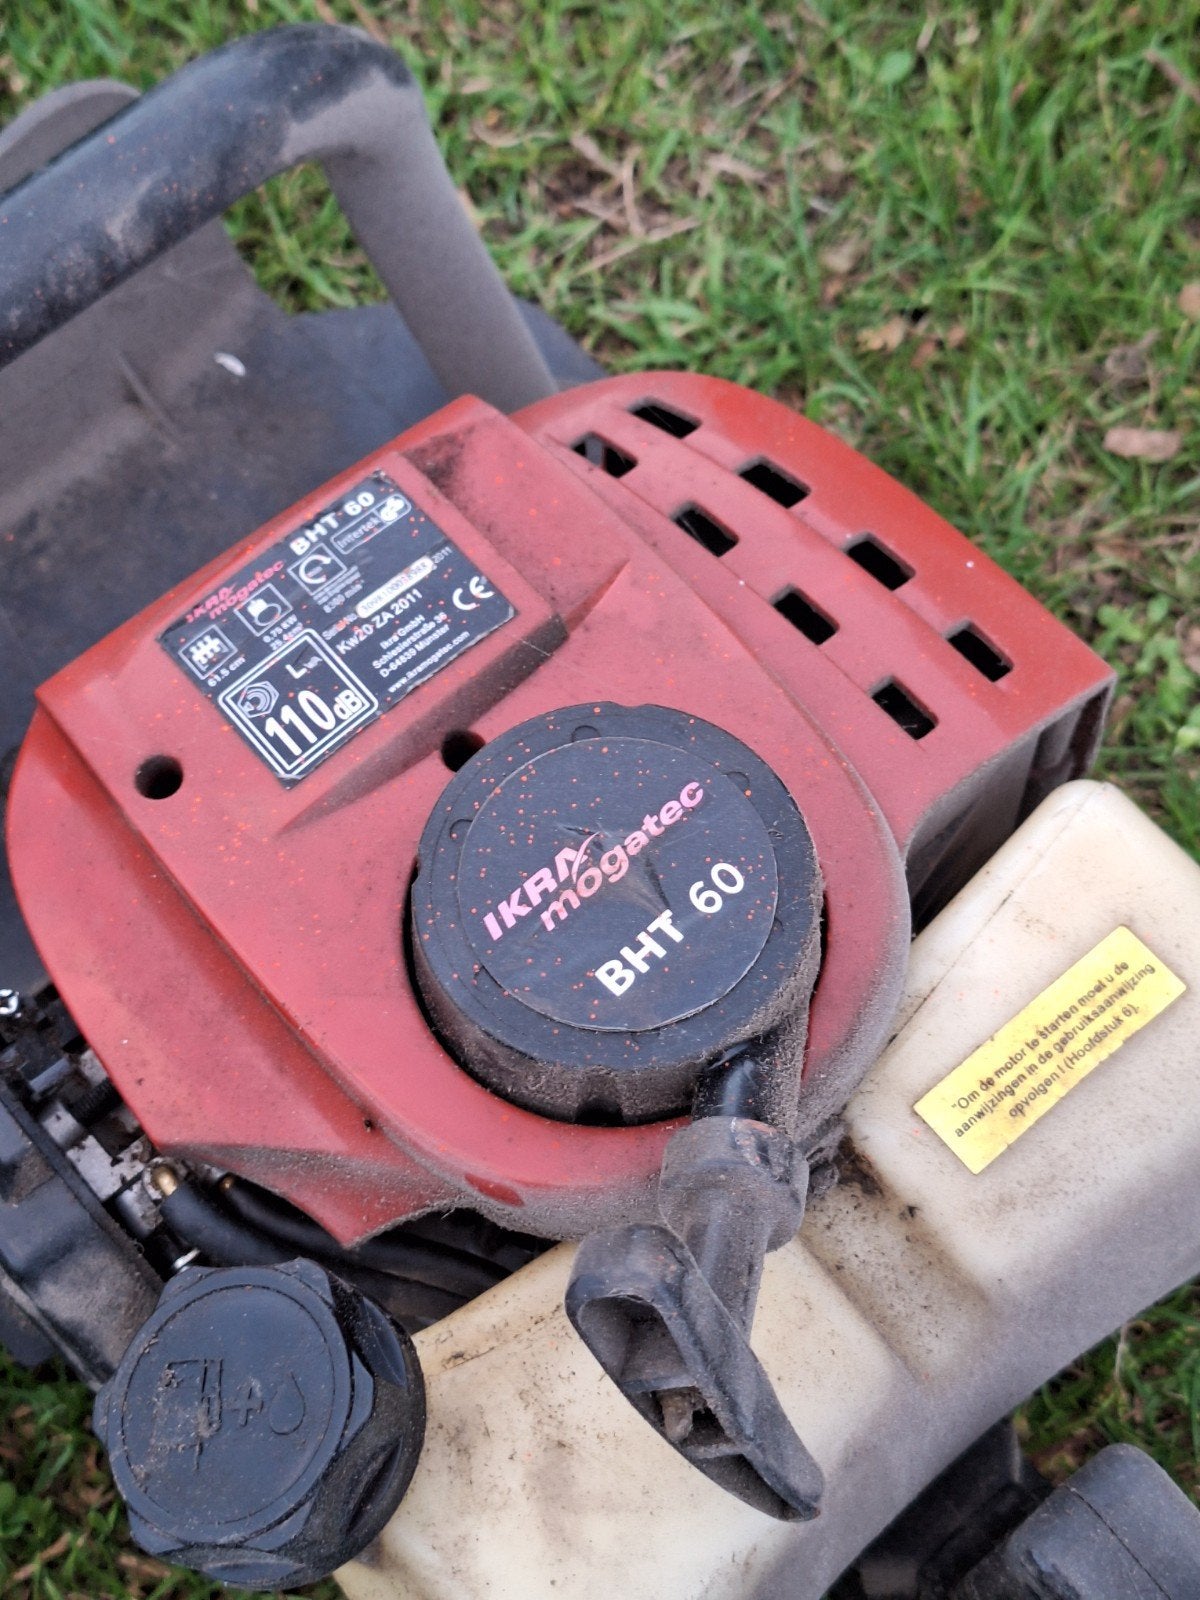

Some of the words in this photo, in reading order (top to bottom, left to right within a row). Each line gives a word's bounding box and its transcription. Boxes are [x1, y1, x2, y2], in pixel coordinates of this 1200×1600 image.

[289, 511, 340, 556] BHT
[344, 492, 375, 517] 60
[208, 561, 284, 620] mogatec
[371, 612, 395, 629] ZA
[390, 588, 423, 616] 2011
[380, 634, 400, 650] Ikra
[397, 614, 426, 638] GmbH
[207, 668, 231, 688] 61.5
[228, 656, 247, 672] cm
[483, 832, 599, 941] IKRA
[541, 779, 706, 932] mogatec
[595, 909, 684, 997] BHT
[689, 865, 742, 912] 60
[954, 1073, 1028, 1138] aanwijzingen
[1025, 1062, 1039, 1076] in
[1036, 1049, 1054, 1066] de
[1053, 963, 1156, 1050] gebruiksaanwijzing
[977, 1075, 996, 1092] de
[994, 1047, 1028, 1079] motor
[1026, 1037, 1041, 1051] te
[1038, 1003, 1079, 1041] starten
[1077, 980, 1107, 1008] moet
[1106, 974, 1115, 984] u
[1112, 960, 1130, 977] de
[1008, 1070, 1060, 1119] opvolgen
[1063, 1014, 1124, 1070] (Hoofdstuk
[1121, 1002, 1140, 1018] 6).
